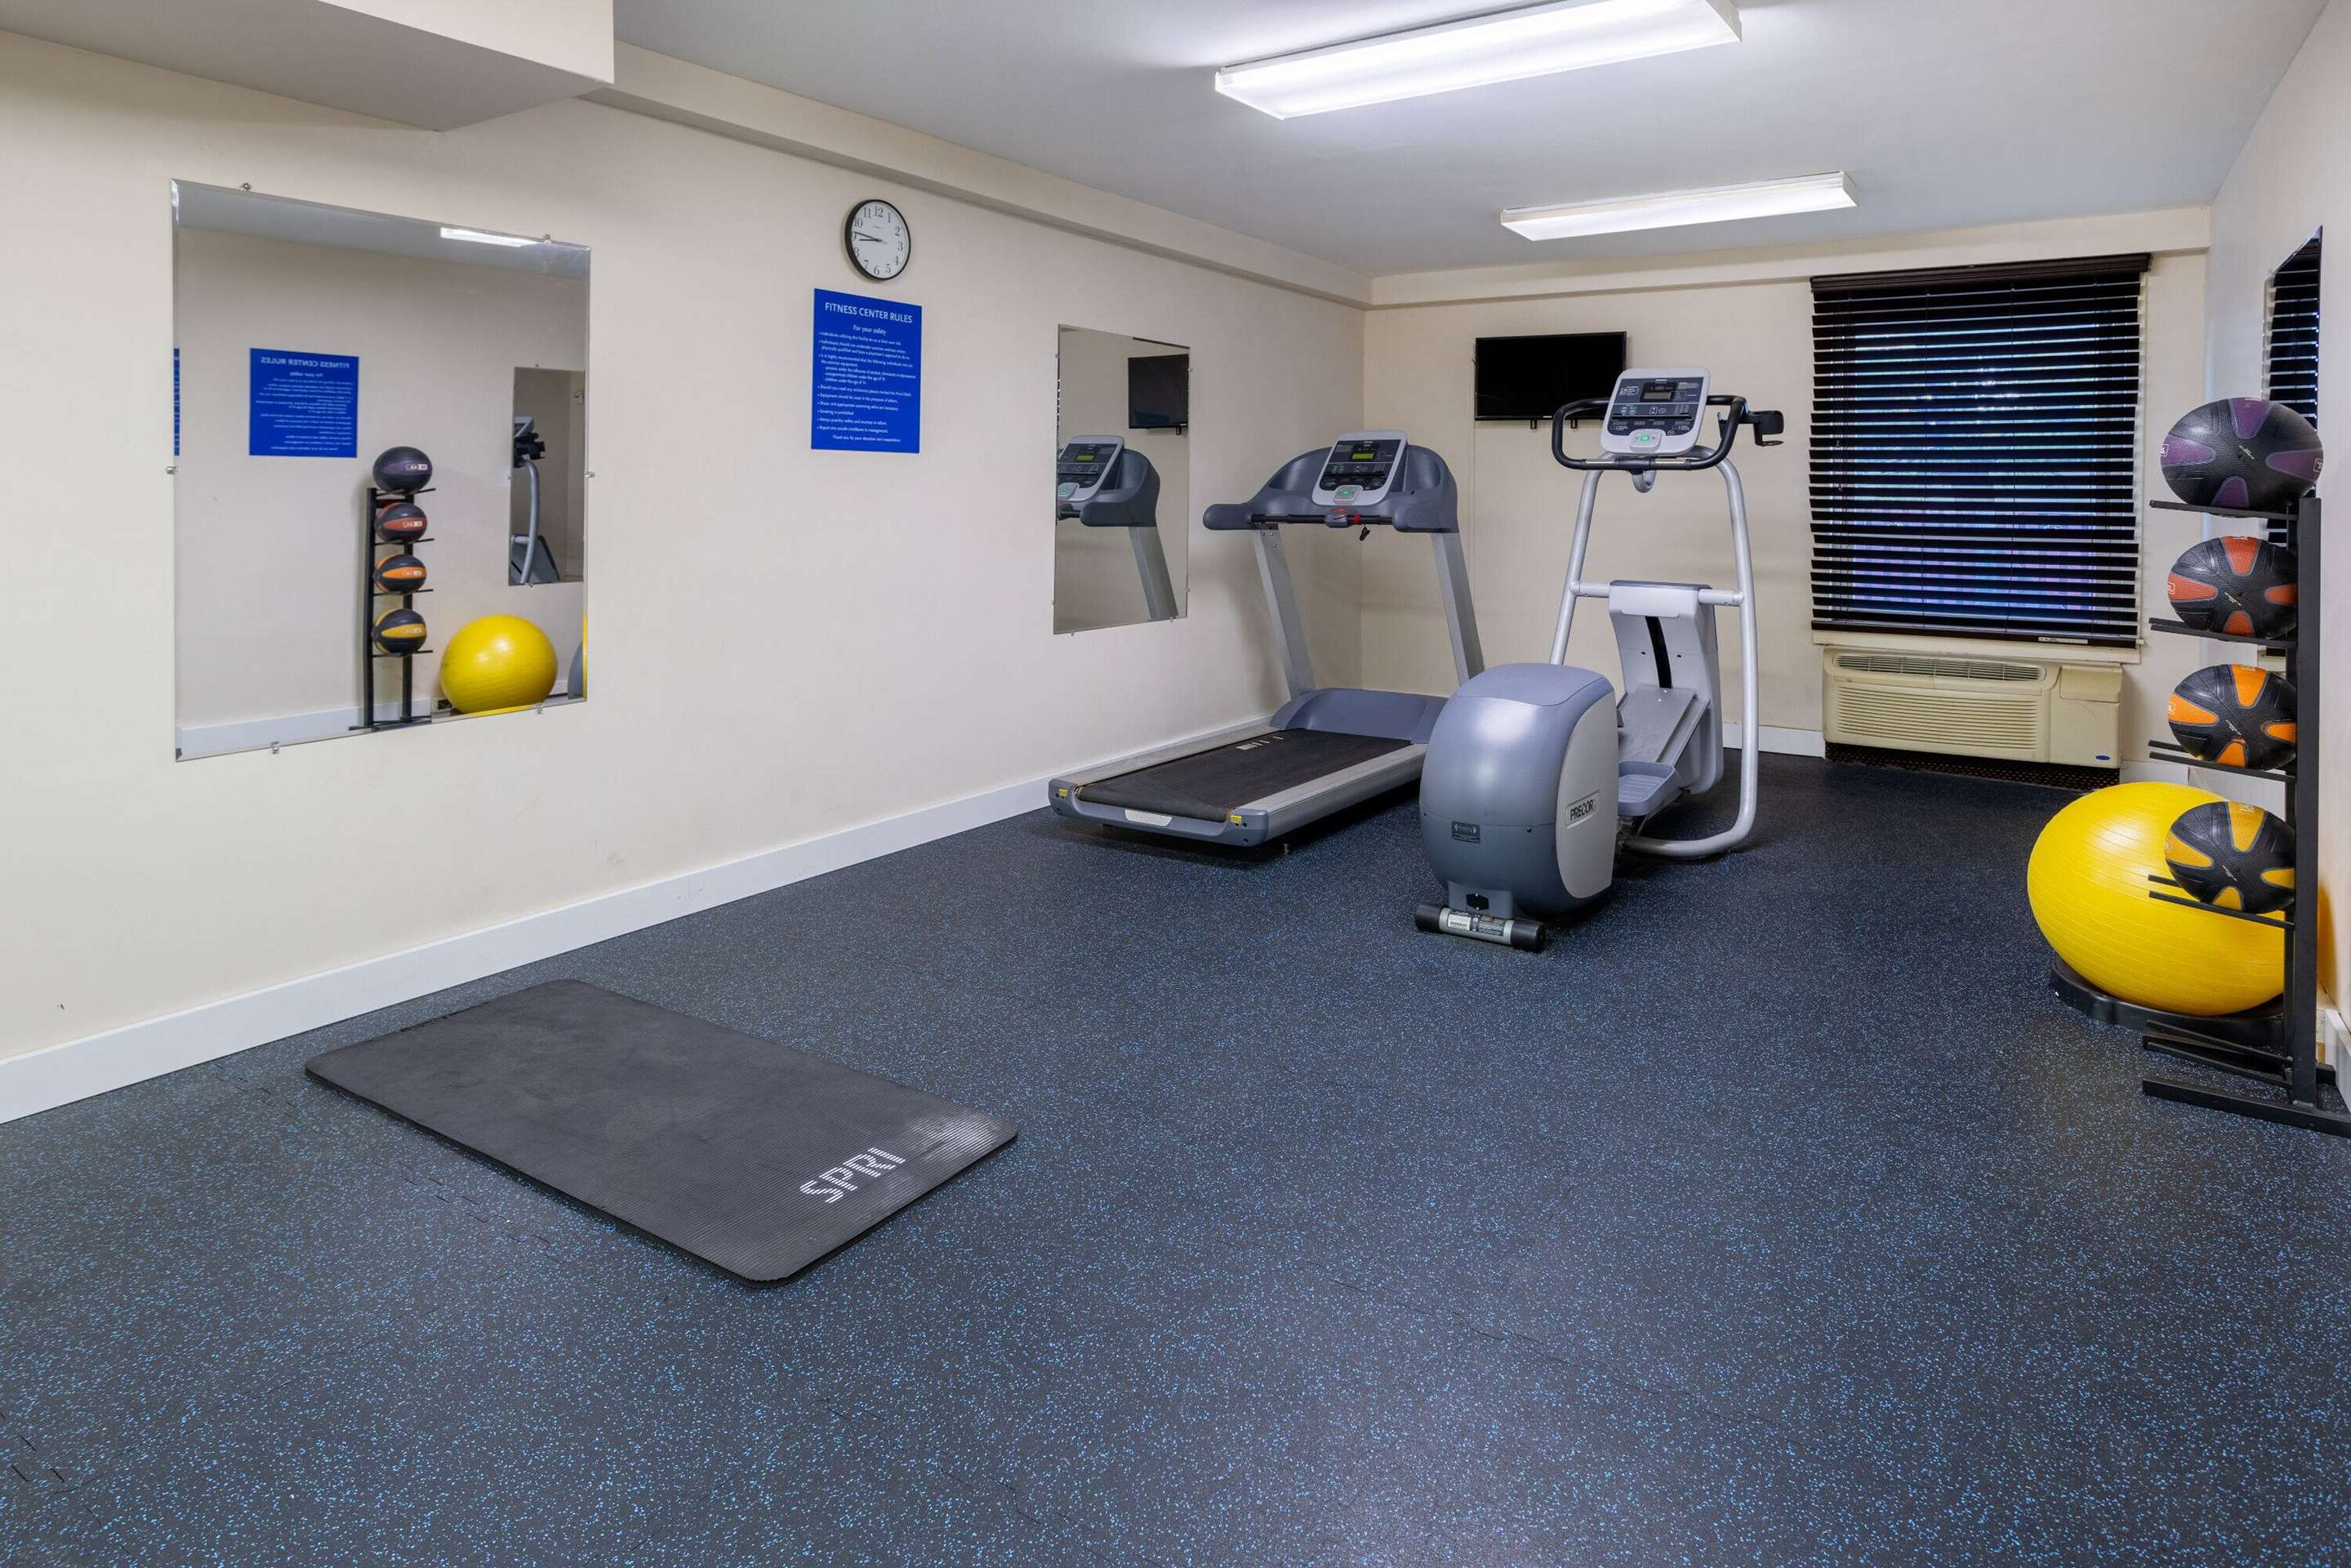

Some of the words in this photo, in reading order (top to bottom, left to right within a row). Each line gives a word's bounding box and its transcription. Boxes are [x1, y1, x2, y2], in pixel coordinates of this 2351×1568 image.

[863, 207, 870, 218] 11
[875, 206, 884, 217] 12
[854, 216, 863, 228] 10
[894, 225, 901, 237] 2
[897, 241, 903, 252] 3
[874, 265, 880, 276] 6
[885, 263, 892, 274] 5
[825, 302, 857, 315] FITNESS
[858, 307, 888, 320] CENTER
[889, 312, 913, 323] RULES
[873, 327, 887, 336] safety
[1570, 799, 1594, 822] PRECOR
[799, 1147, 906, 1204] SPRI
